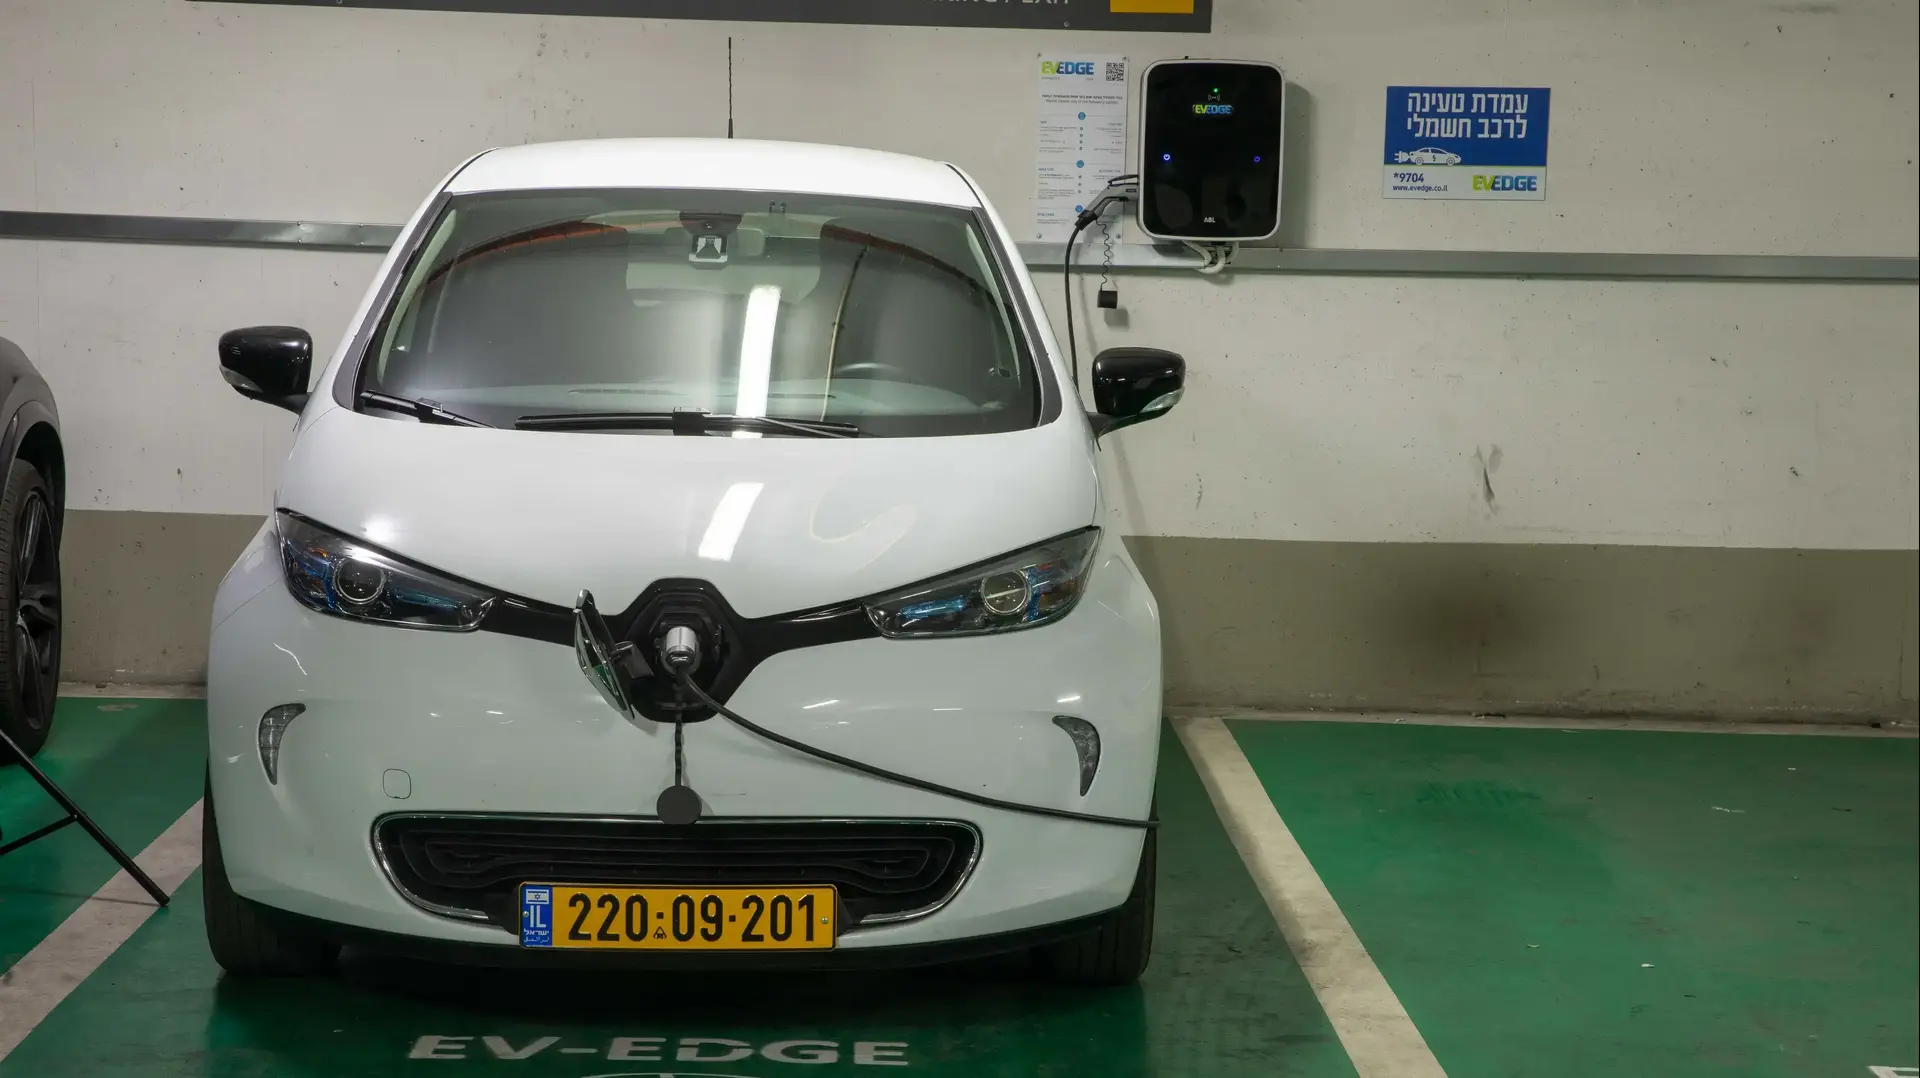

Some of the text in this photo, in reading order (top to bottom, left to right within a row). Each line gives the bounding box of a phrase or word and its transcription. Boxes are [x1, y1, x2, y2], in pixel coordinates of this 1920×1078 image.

[1041, 61, 1095, 75] EVEDGE
[1194, 104, 1233, 115] EVEDGE
[1408, 93, 1528, 114] עמדת טעינה
[1407, 113, 1527, 138] לרכב חשמלי
[1393, 184, 1448, 192] www.evedge.co.il
[1472, 175, 1537, 191] EVEDGE
[529, 905, 546, 928] IL
[523, 928, 550, 936] ישראל
[407, 1035, 909, 1066] EV-EDGE
